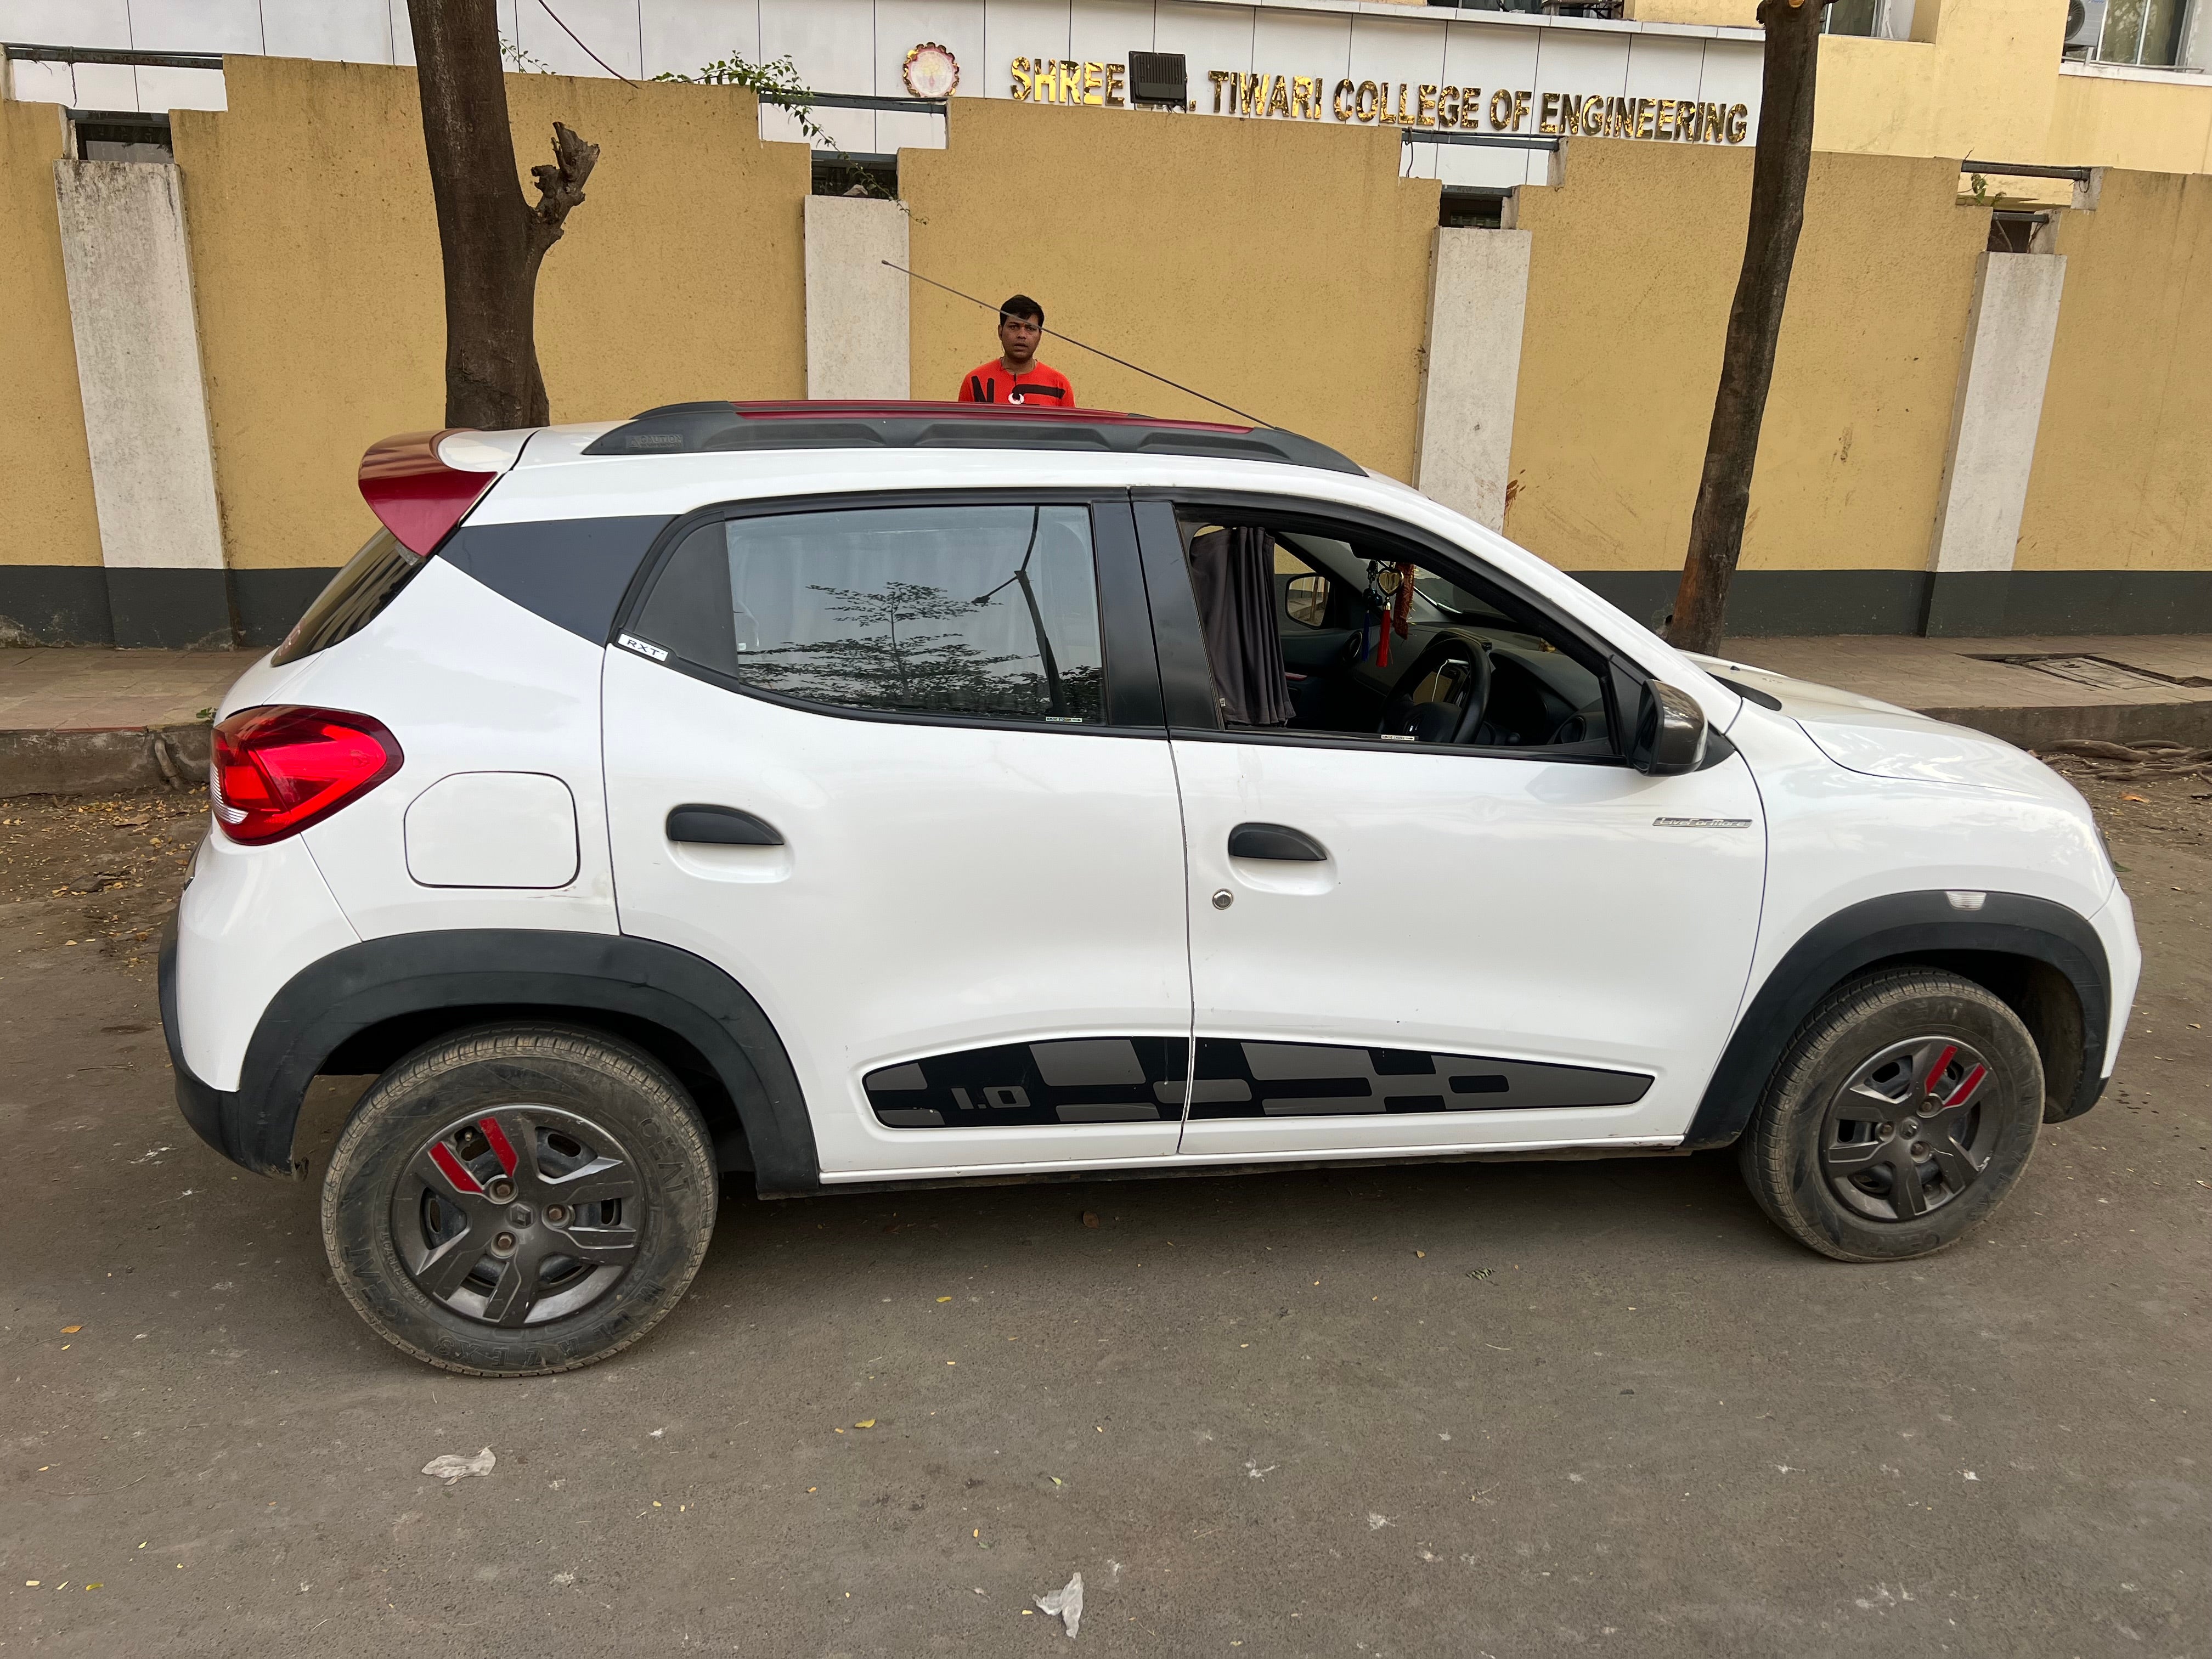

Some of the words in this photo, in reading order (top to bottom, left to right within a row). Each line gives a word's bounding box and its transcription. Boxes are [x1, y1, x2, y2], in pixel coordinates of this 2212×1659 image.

[1010, 57, 1125, 107] SHREE
[1207, 70, 1323, 119] TIWARI
[1334, 78, 1481, 129] COLLEGE
[1490, 88, 1532, 132] OF
[1539, 92, 1748, 144] ENGINEERING
[640, 434, 682, 443] CAUTION
[627, 639, 660, 656] RXT
[950, 1086, 1031, 1110] 1.0
[636, 1118, 692, 1193] CEAT
[343, 1245, 405, 1321] CEAT
